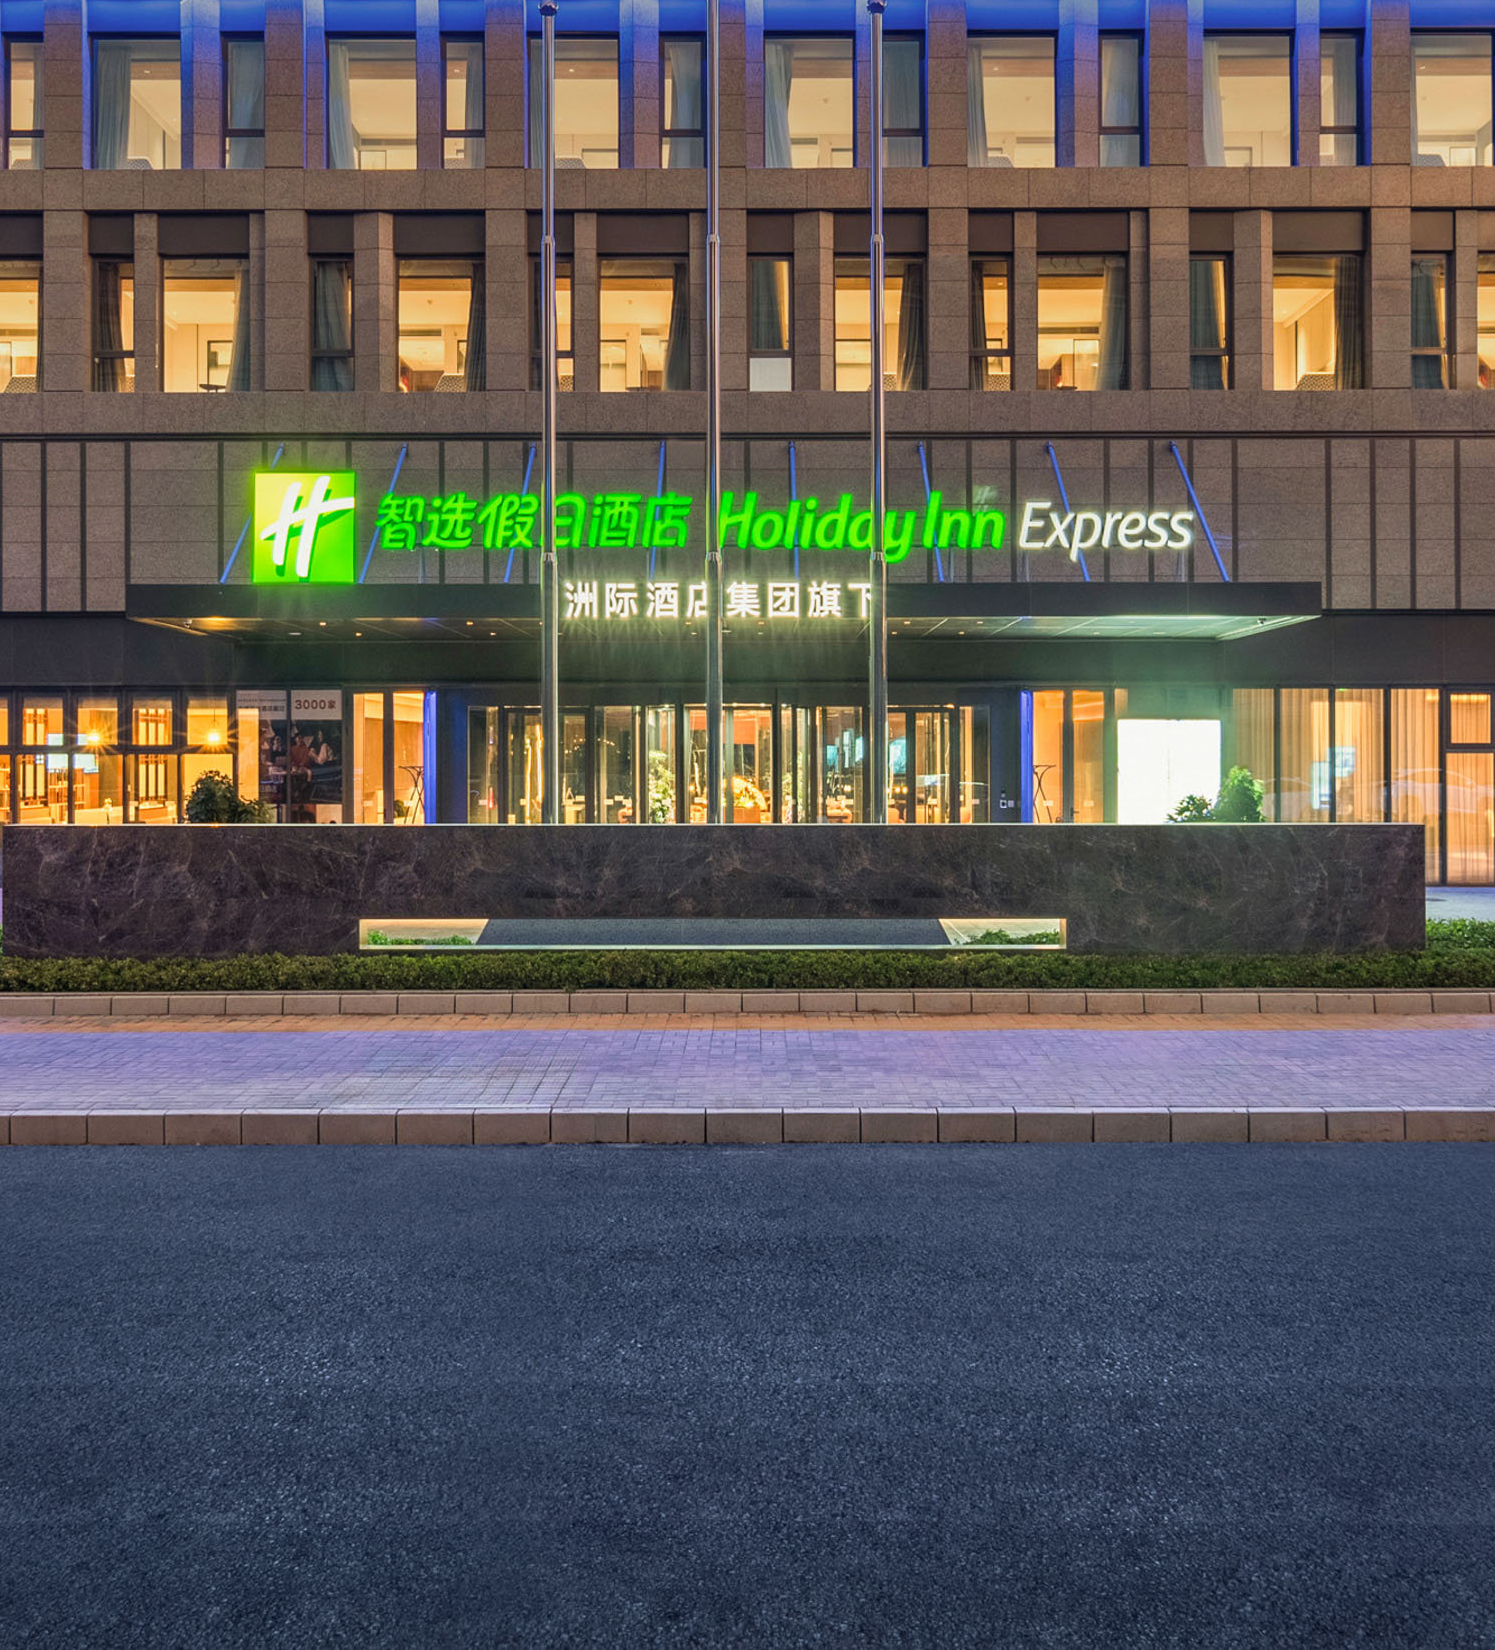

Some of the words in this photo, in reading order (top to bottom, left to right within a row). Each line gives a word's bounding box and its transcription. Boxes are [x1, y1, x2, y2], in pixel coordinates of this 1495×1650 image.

[374, 491, 694, 550] 智选假日酒店
[718, 491, 916, 564] Holiday
[921, 490, 1006, 550] Inn
[1018, 501, 1195, 562] Express
[564, 581, 872, 618] 洲际酒店集团旗下
